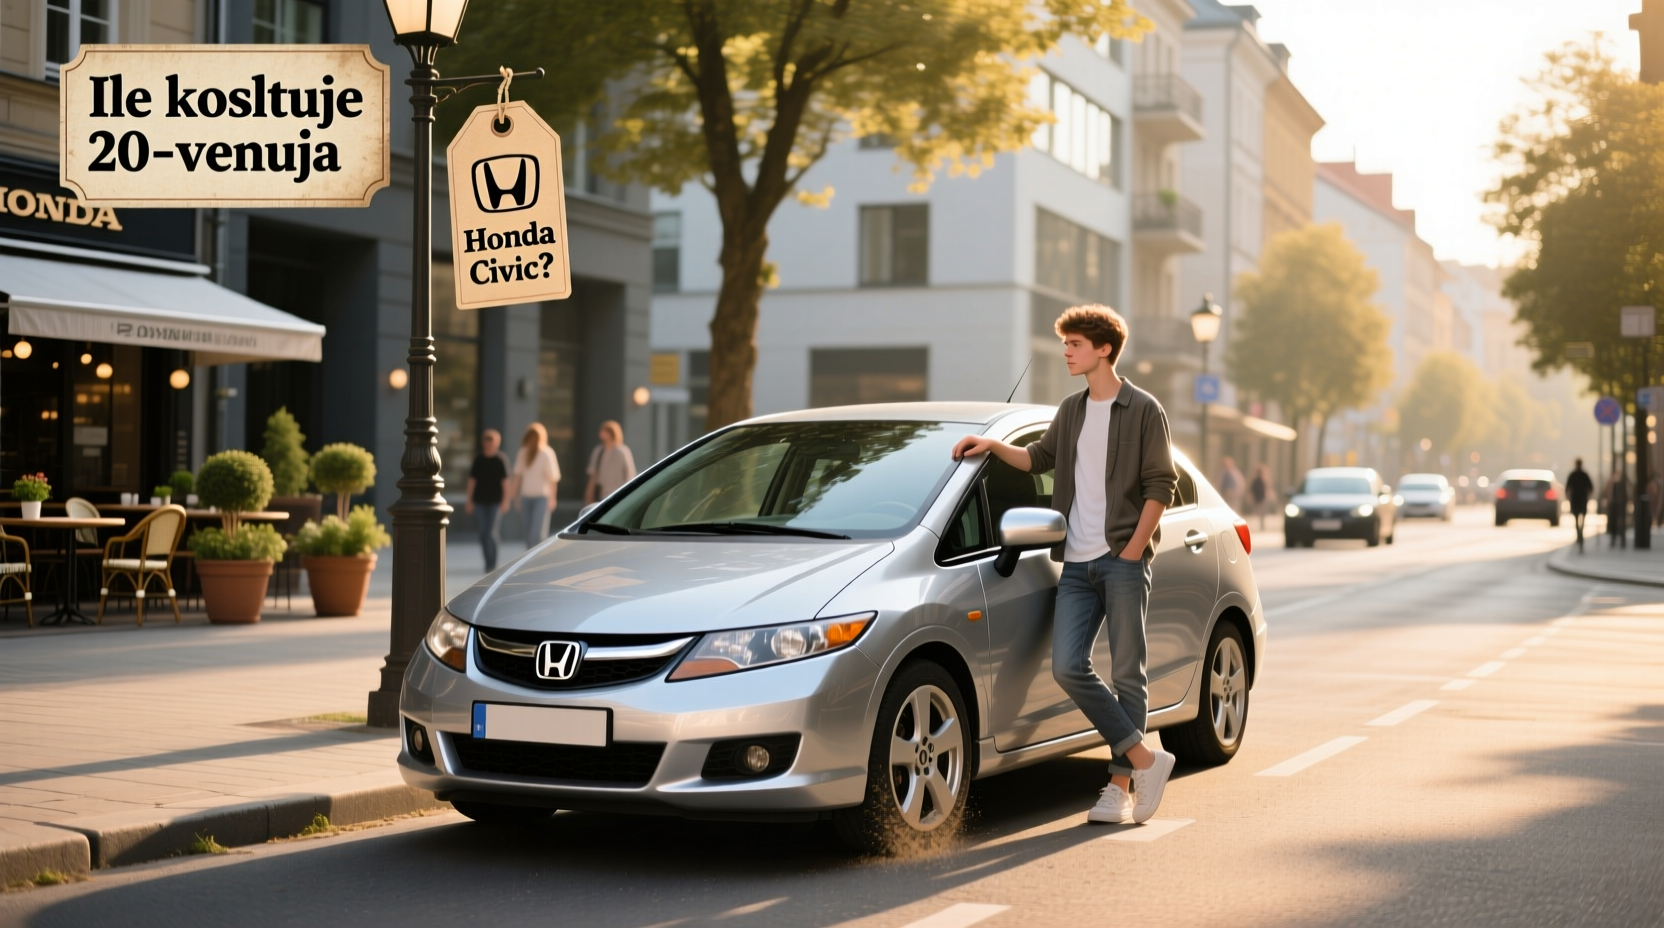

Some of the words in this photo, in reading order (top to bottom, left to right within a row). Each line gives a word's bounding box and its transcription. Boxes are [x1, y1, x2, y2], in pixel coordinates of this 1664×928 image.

[89, 73, 152, 118] Ile
[165, 73, 363, 129] kosltuje
[88, 128, 342, 183] 20-venuja
[463, 221, 556, 253] Honda
[469, 252, 554, 285] Civic?
